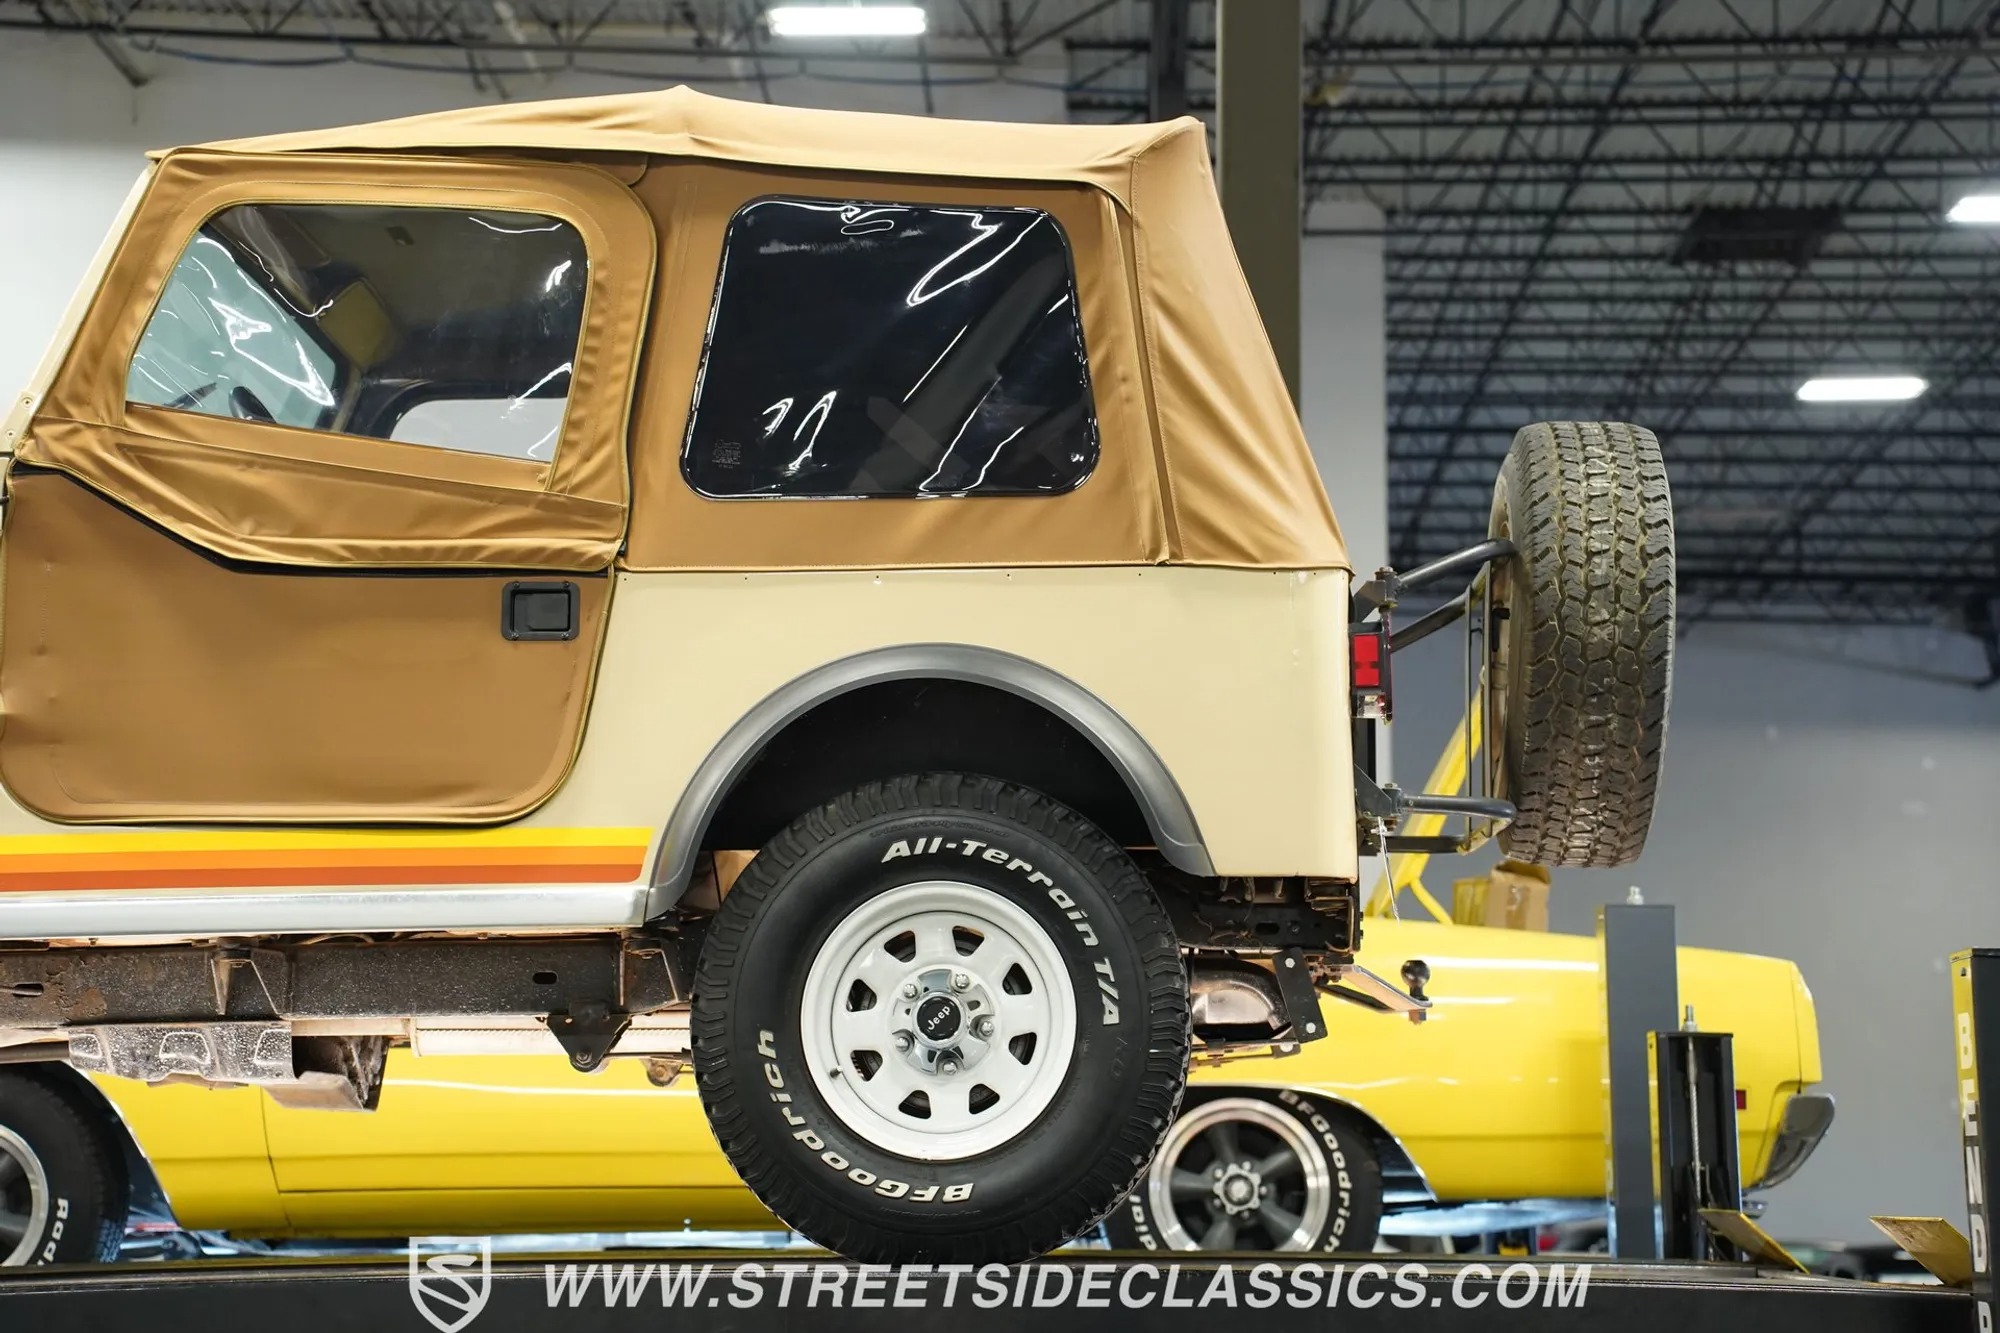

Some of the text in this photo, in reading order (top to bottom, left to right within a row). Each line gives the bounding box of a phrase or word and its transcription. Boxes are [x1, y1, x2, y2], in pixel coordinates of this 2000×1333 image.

[881, 836, 1100, 947] All-Terrain
[1093, 958, 1120, 1027] T/A
[928, 1005, 951, 1031] Jeep
[757, 1029, 975, 1203] BFGoodrich
[1278, 1088, 1353, 1254] BFGoodrich
[37, 1197, 70, 1266] Rad
